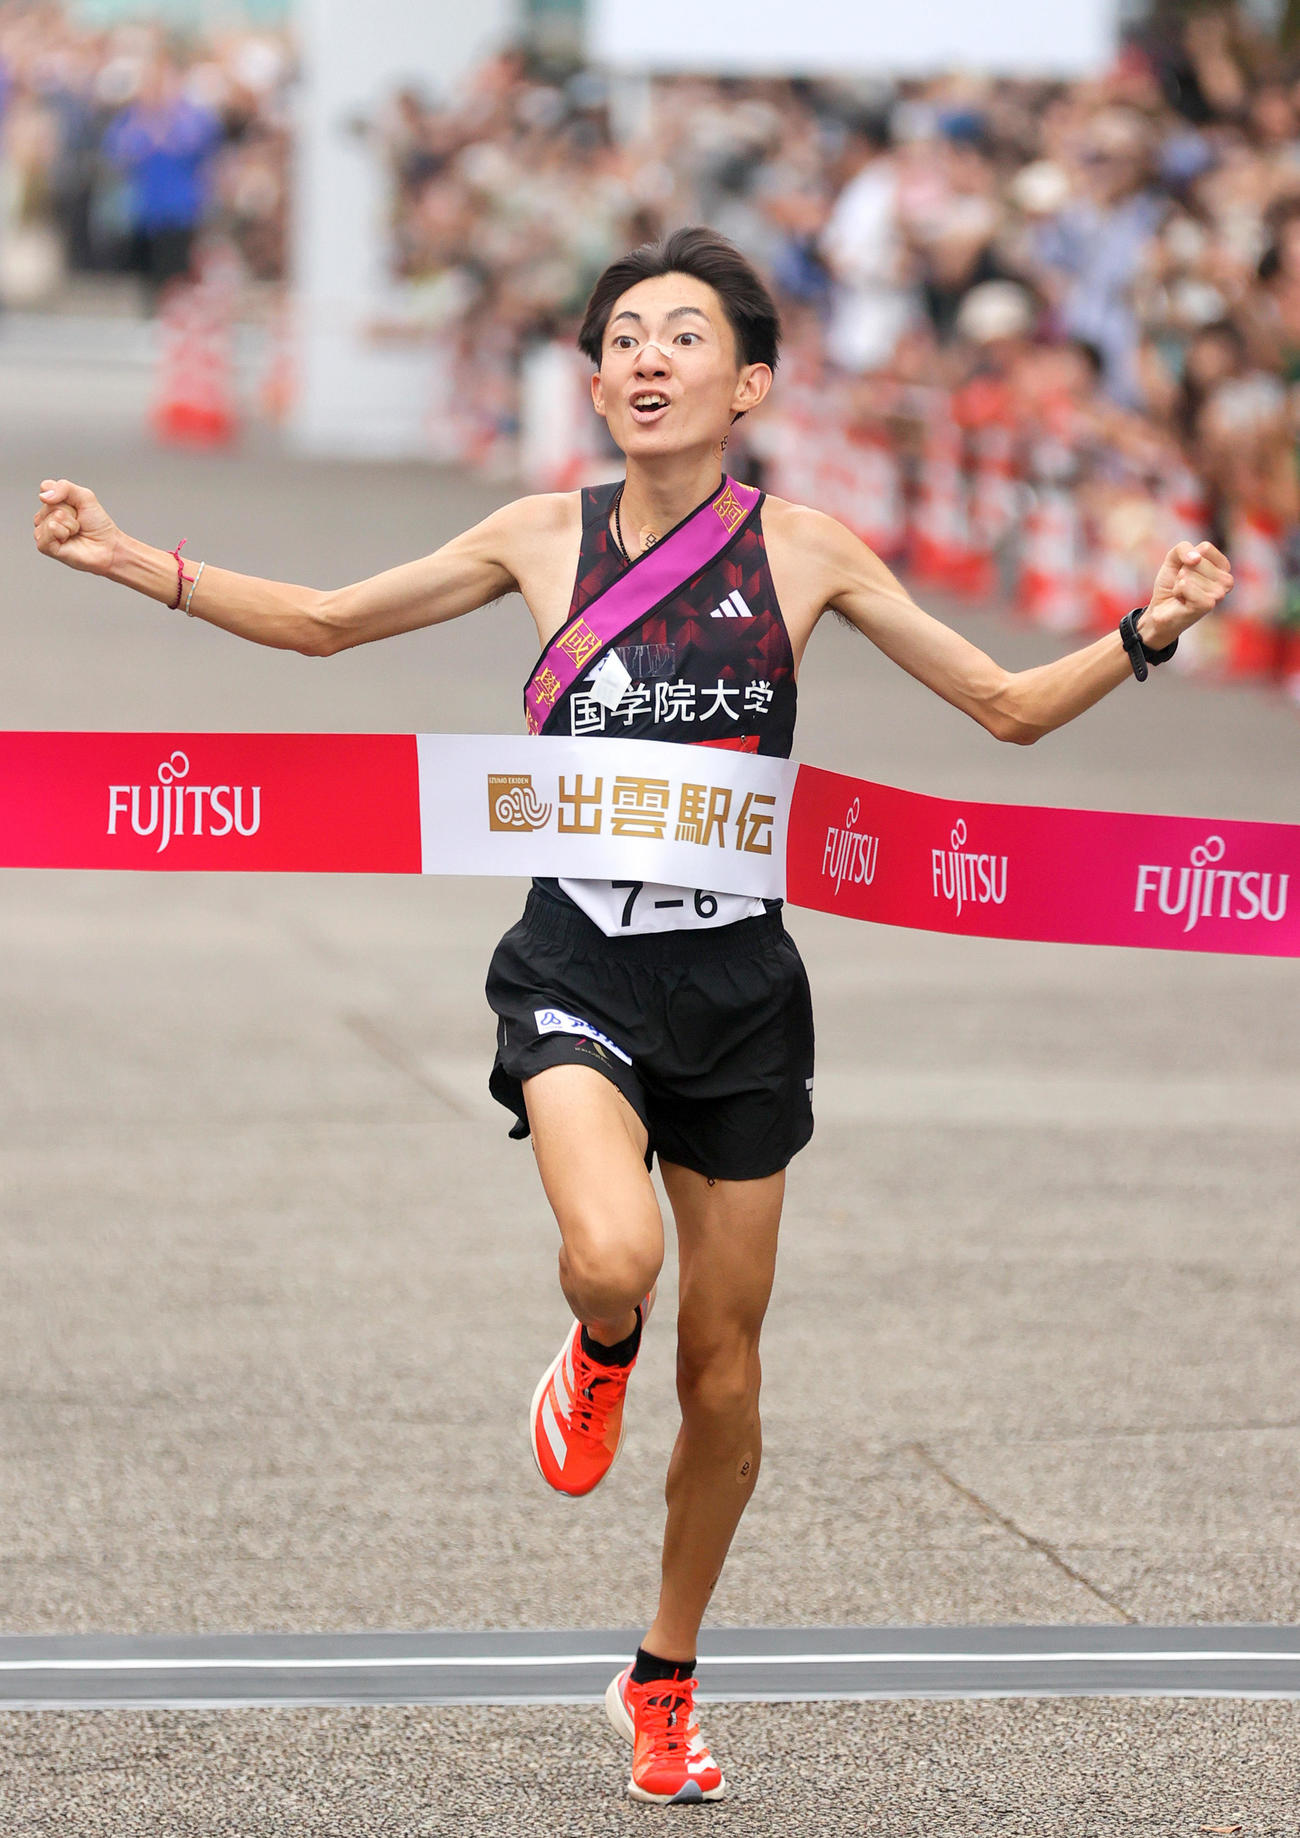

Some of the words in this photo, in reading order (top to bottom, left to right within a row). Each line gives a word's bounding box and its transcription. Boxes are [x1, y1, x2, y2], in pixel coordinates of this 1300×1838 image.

[713, 482, 755, 534] 國
[570, 678, 774, 736] 国学院大学
[106, 751, 262, 854] FUJITSU
[558, 774, 776, 855] 出雲駅伝
[821, 797, 880, 896] FUJITSU
[932, 818, 1009, 918] FUJITSU
[1134, 835, 1290, 933] FUJITSU
